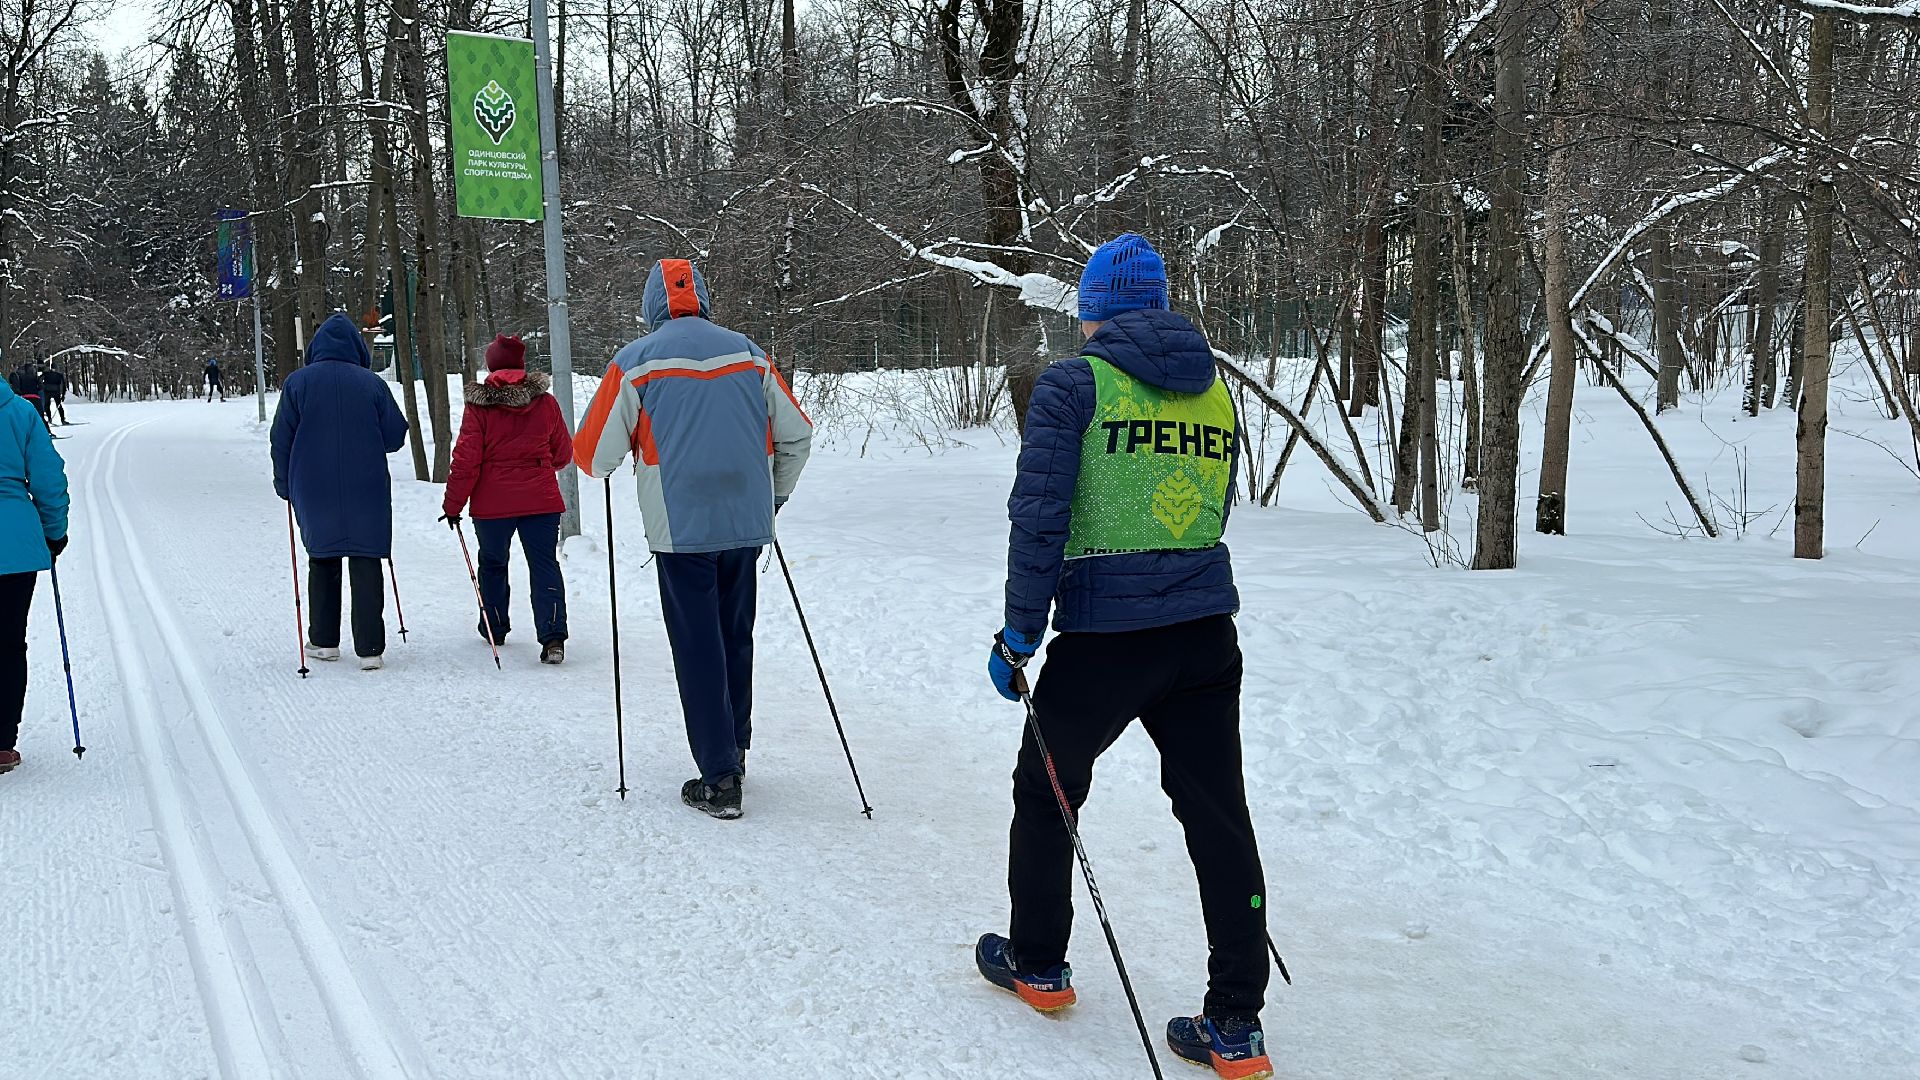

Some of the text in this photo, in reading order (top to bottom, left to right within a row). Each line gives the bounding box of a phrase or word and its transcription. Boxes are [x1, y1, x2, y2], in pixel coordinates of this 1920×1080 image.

[468, 149, 526, 160] ОДИНЦОВСКИЙ
[468, 159, 528, 171] ПАРК КУЛЬТУРЫ,
[464, 168, 494, 177] СПОРТА
[502, 171, 532, 180] ОТДЫХА
